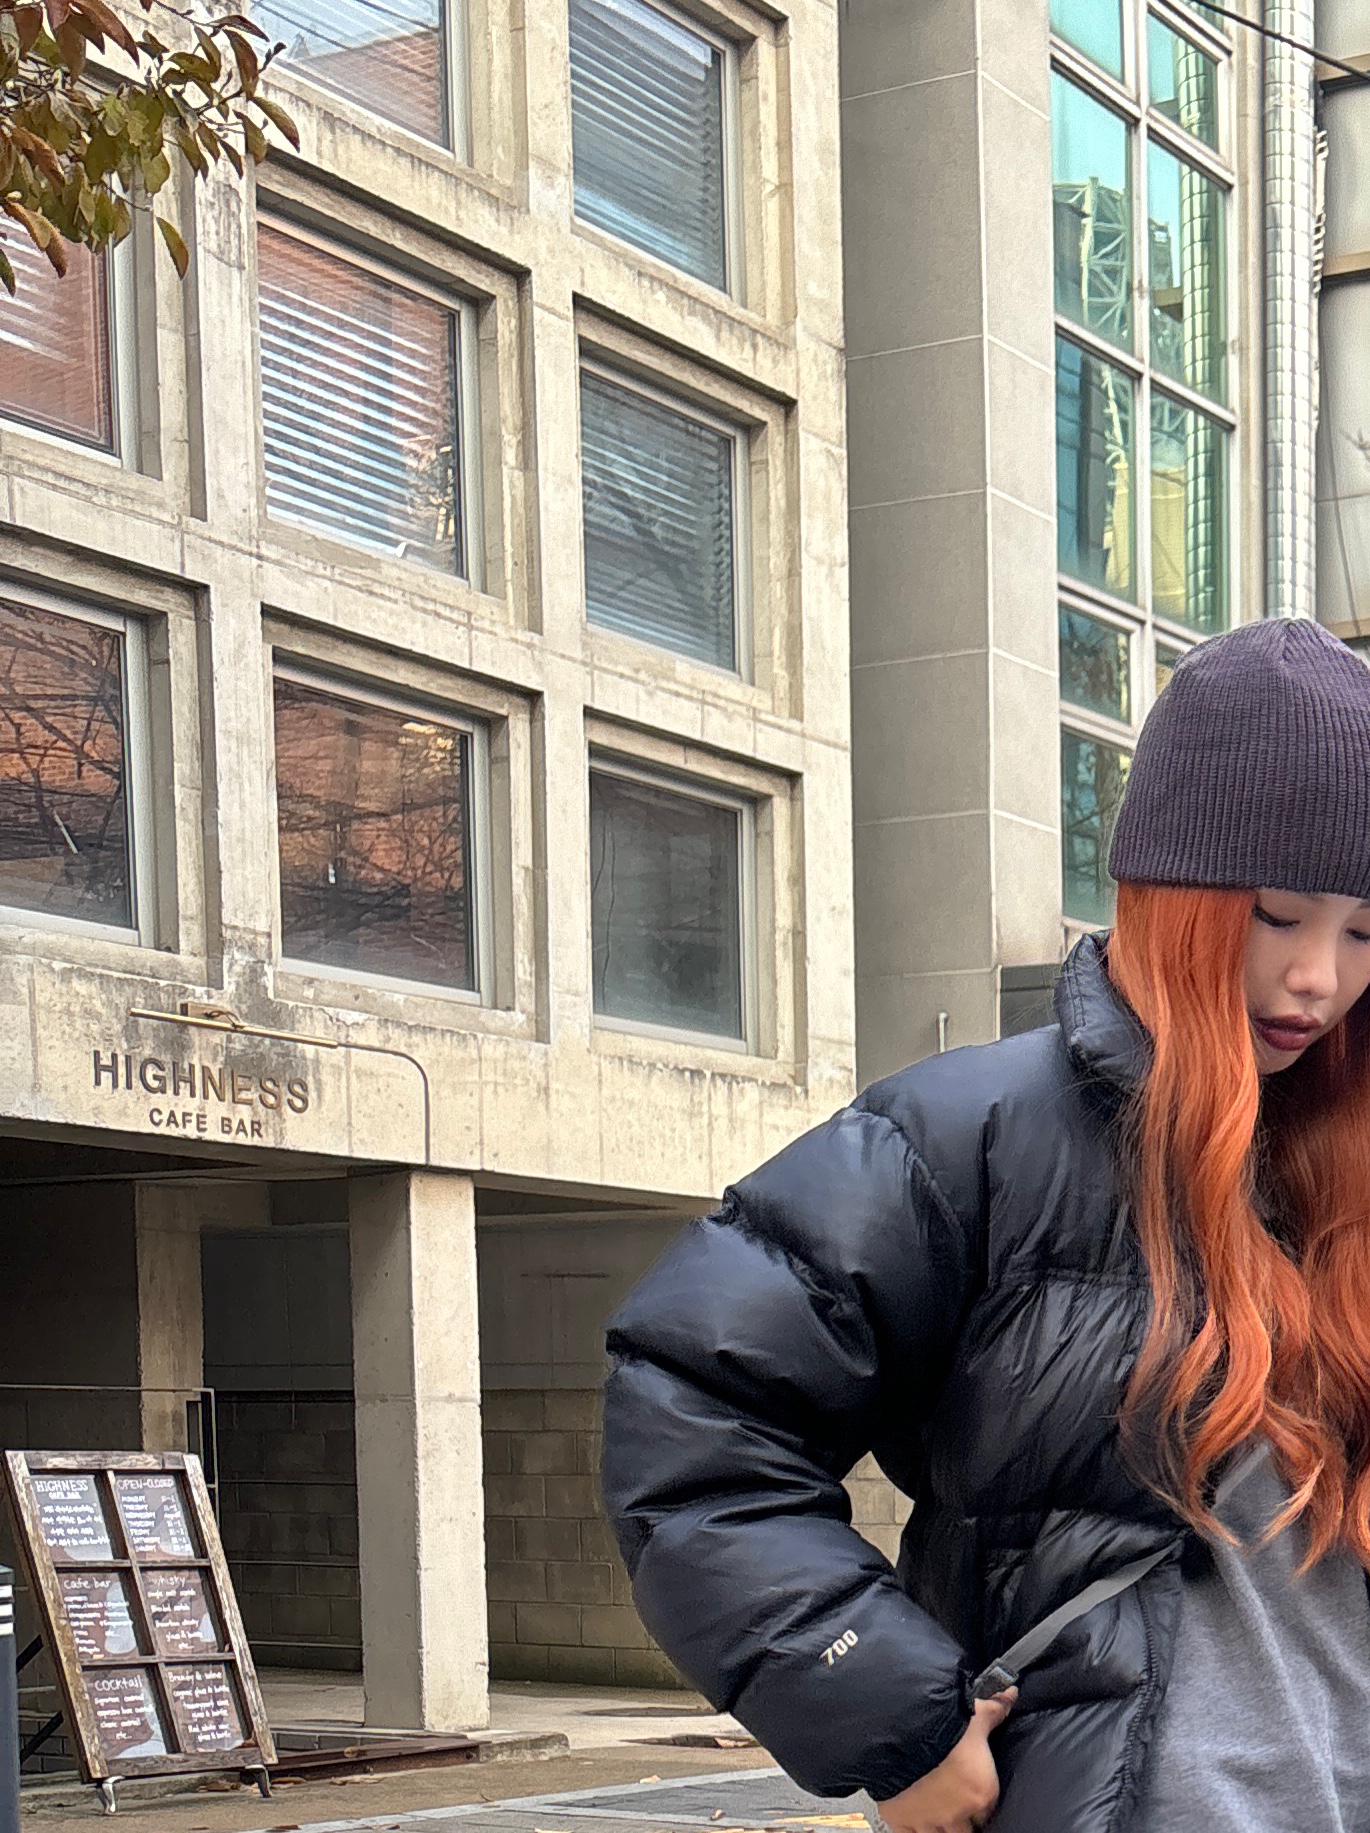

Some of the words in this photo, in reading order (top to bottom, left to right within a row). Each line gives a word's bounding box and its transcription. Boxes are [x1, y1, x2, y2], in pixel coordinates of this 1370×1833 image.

[94, 1050, 309, 1114] HIGHNESS
[149, 1108, 208, 1133] CAFE
[220, 1116, 263, 1139] BAR
[35, 1480, 89, 1492] HIGHNESS
[63, 1577, 91, 1589] cafe
[92, 1576, 111, 1589] bar
[818, 1629, 859, 1668] 700
